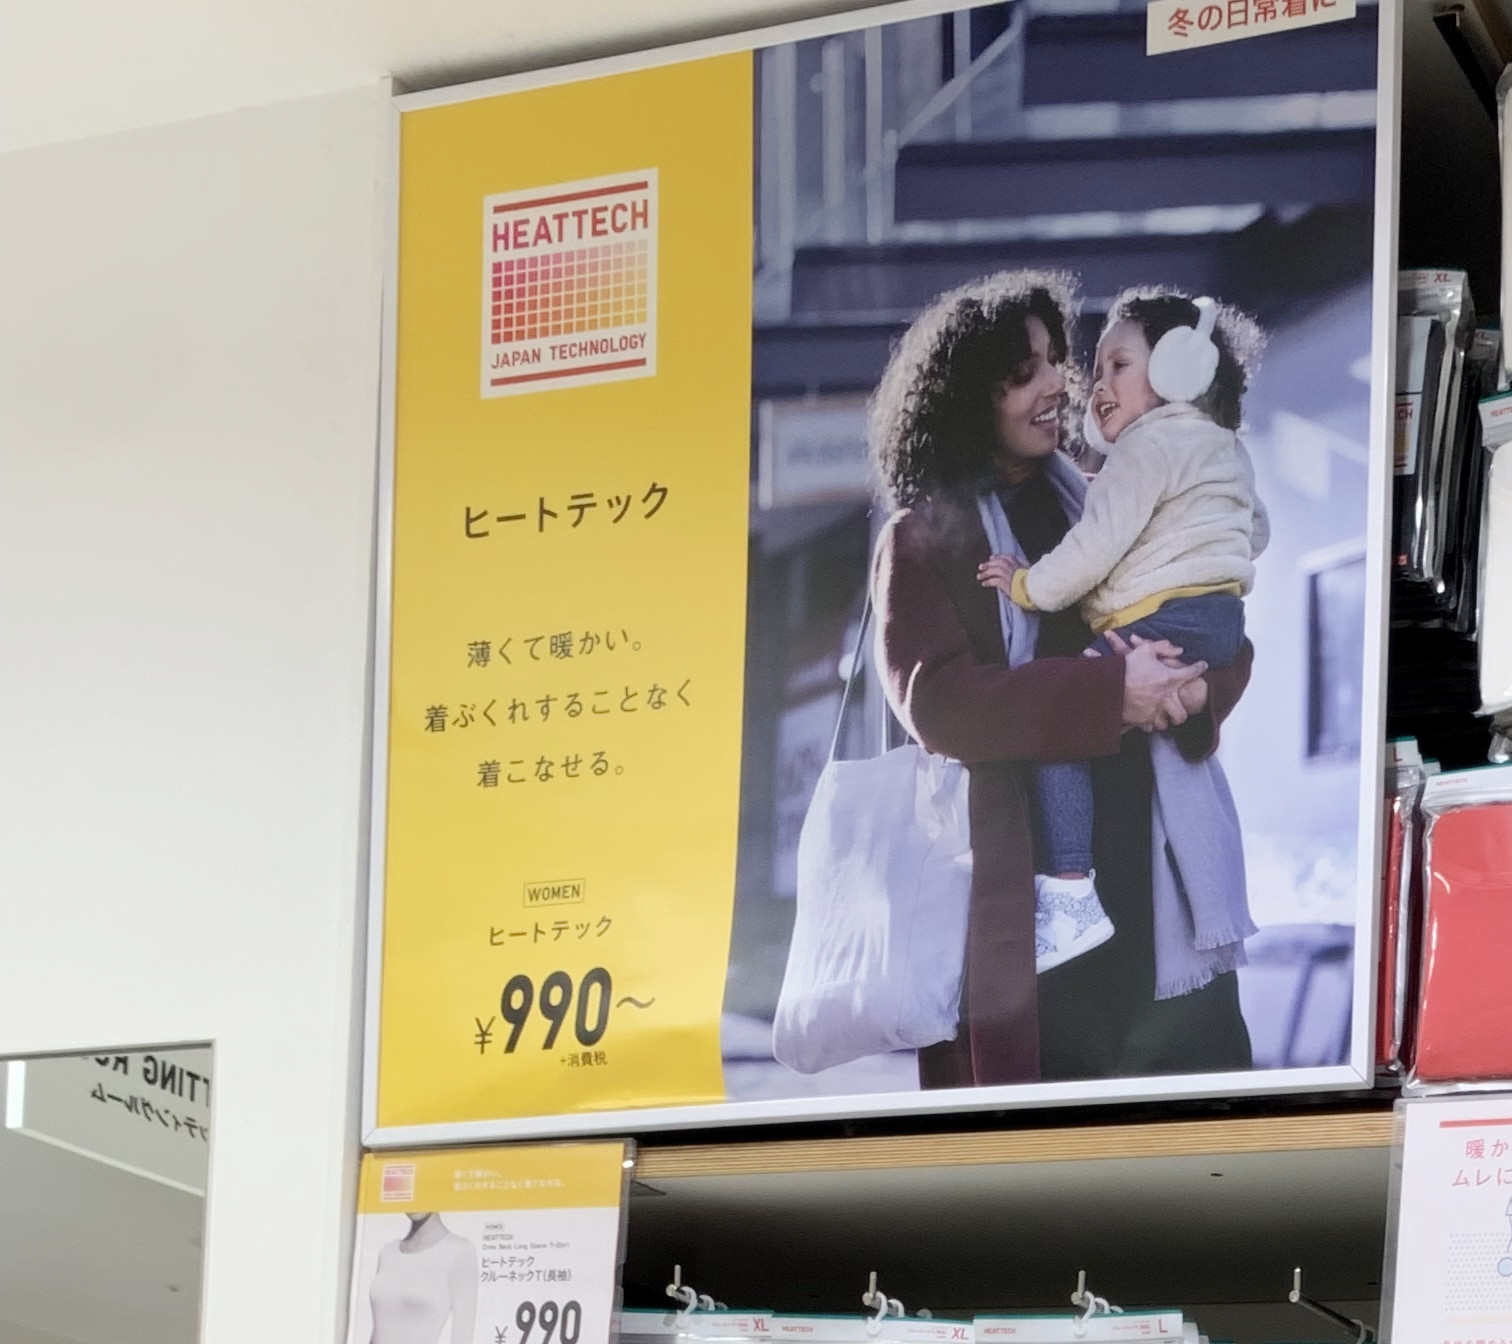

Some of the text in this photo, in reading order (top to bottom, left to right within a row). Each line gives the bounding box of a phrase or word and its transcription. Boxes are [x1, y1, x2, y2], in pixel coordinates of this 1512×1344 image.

[492, 199, 649, 253] HEATTECH
[491, 333, 648, 370] JAPAN TECHNOLOGY
[464, 482, 669, 539] ヒートテック
[466, 629, 642, 669] 薄くて暖かい。
[424, 679, 692, 733] 着ぶくれすることなく
[477, 751, 624, 789] 着こなせる。
[527, 884, 580, 902] WOMEN
[489, 915, 613, 946] ヒートテック
[481, 1256, 535, 1268] ヒートテック
[753, 1318, 769, 1332] XL
[951, 1326, 969, 1340] XL
